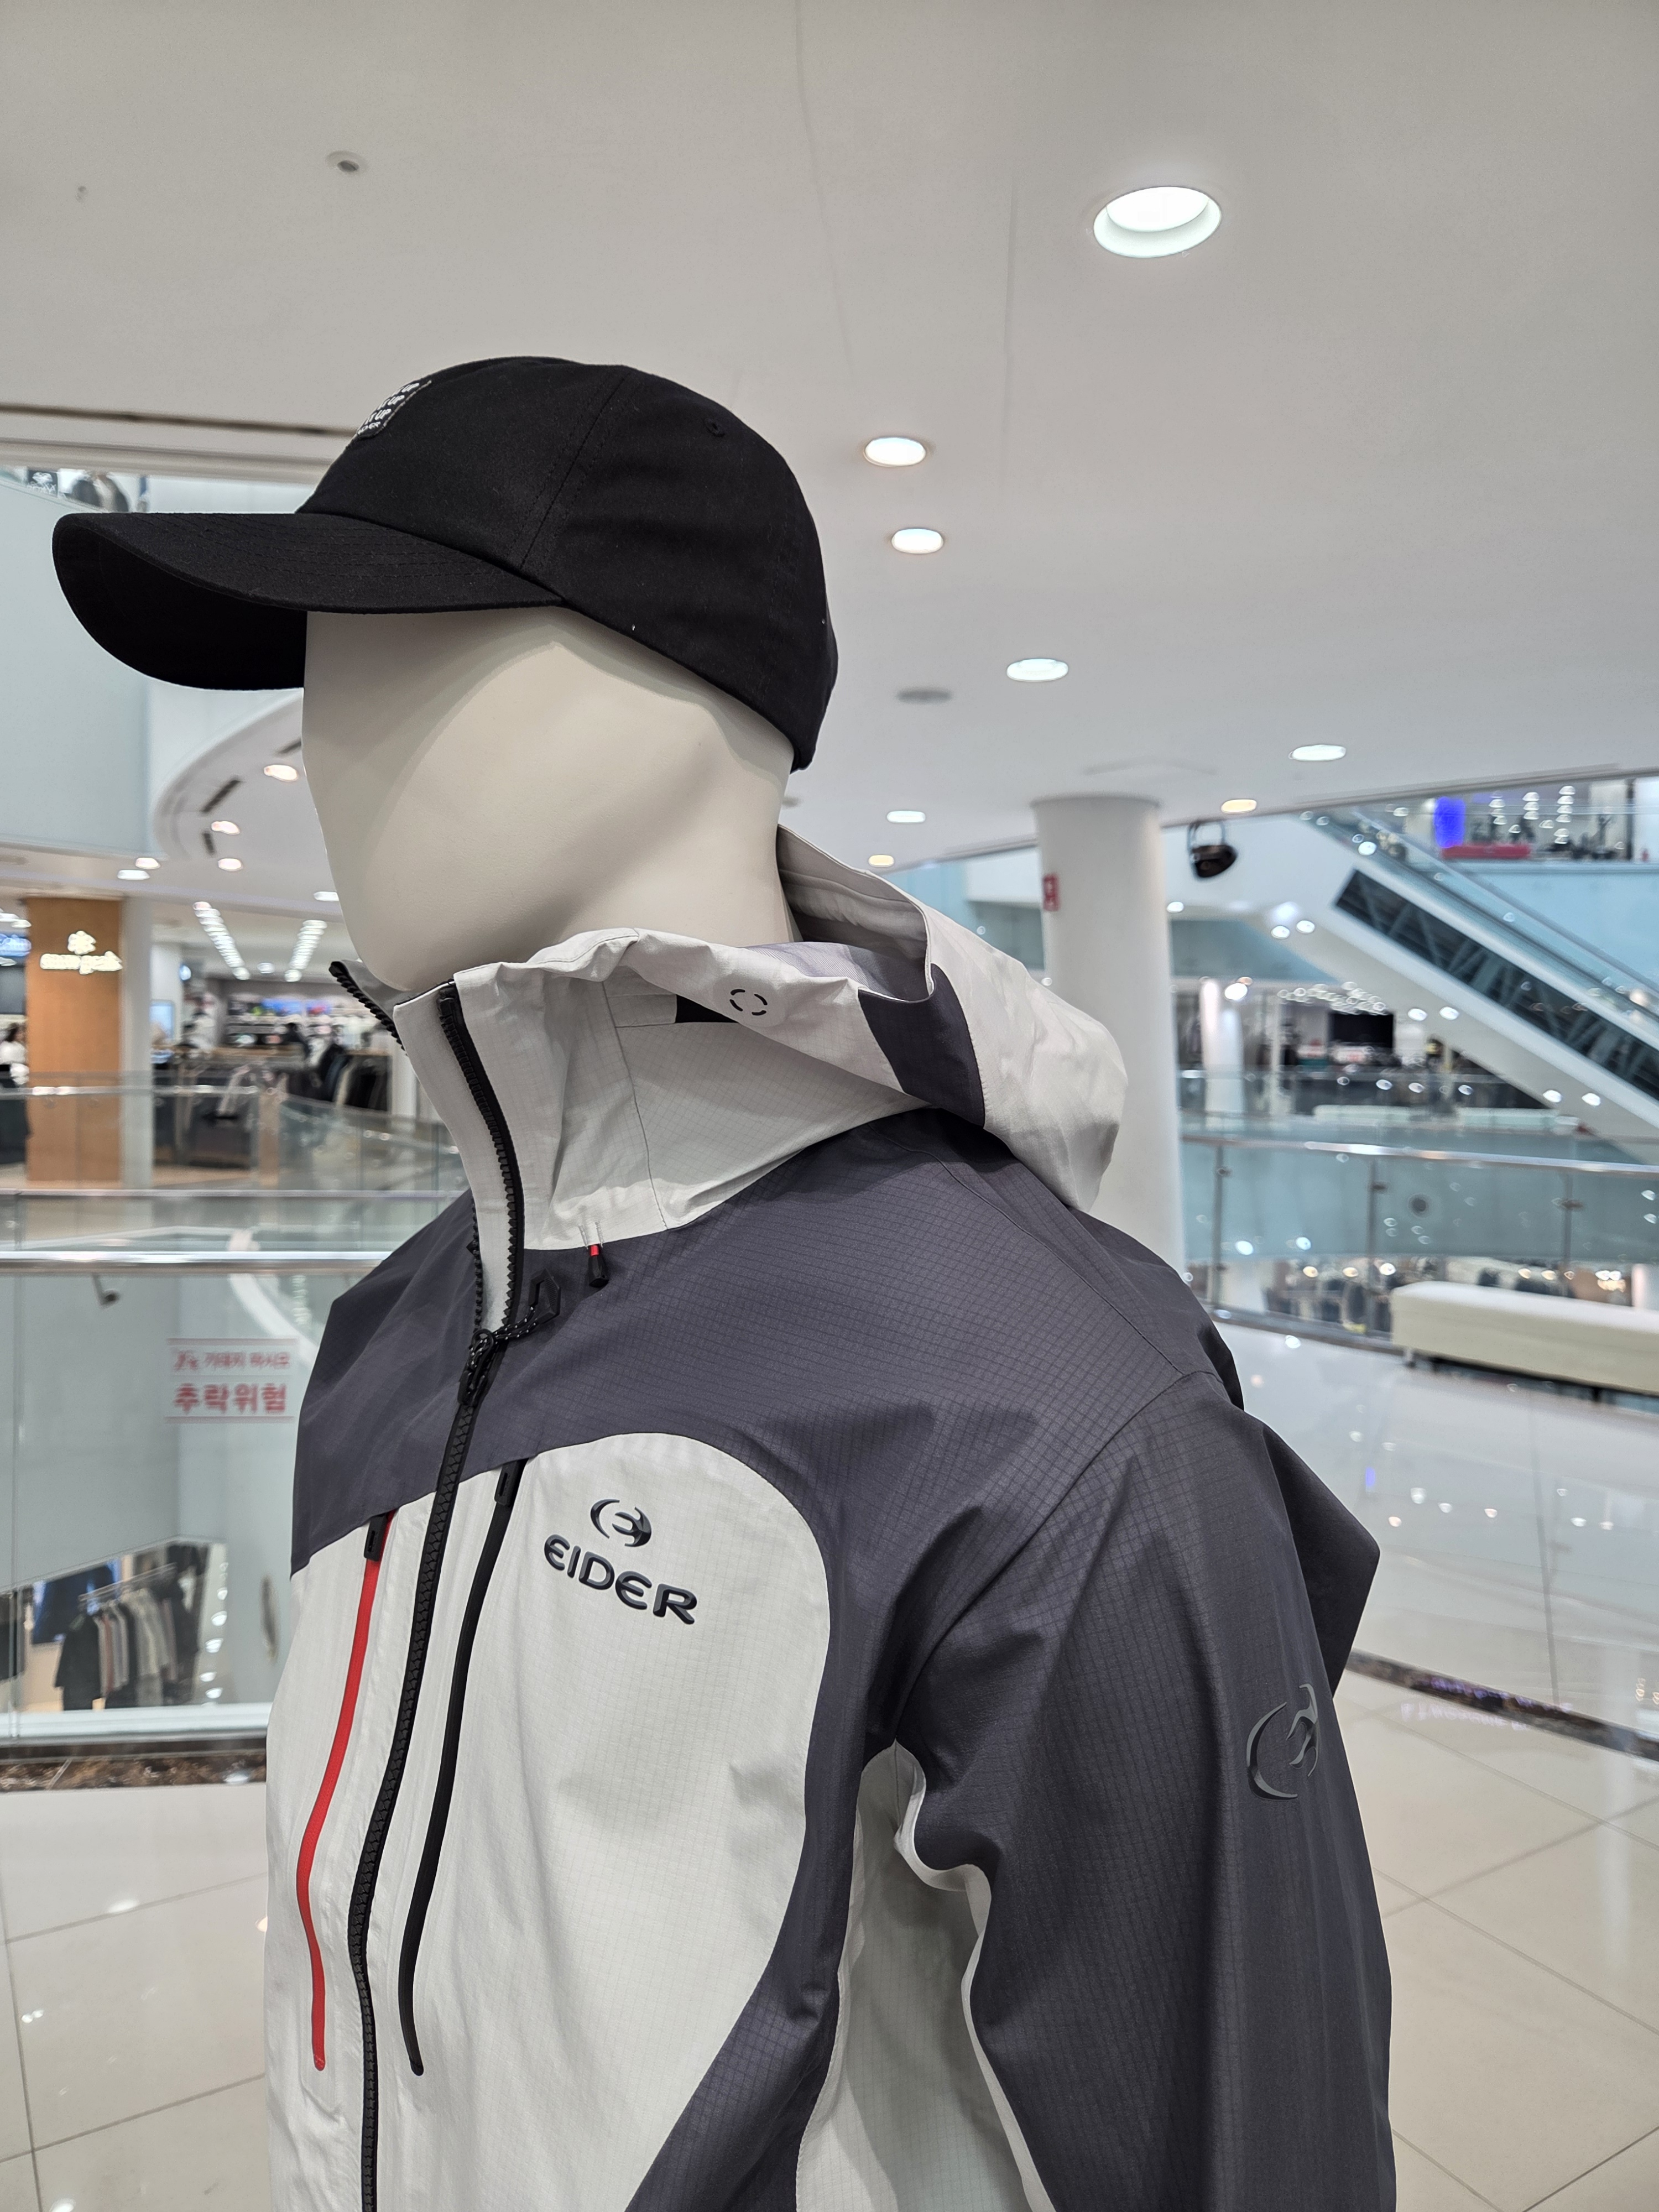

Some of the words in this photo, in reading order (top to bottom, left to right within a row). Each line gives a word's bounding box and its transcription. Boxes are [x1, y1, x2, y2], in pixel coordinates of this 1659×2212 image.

[374, 409, 391, 420] UP
[173, 1382, 287, 1413] 추락위험
[544, 1534, 697, 1625] EIDER
